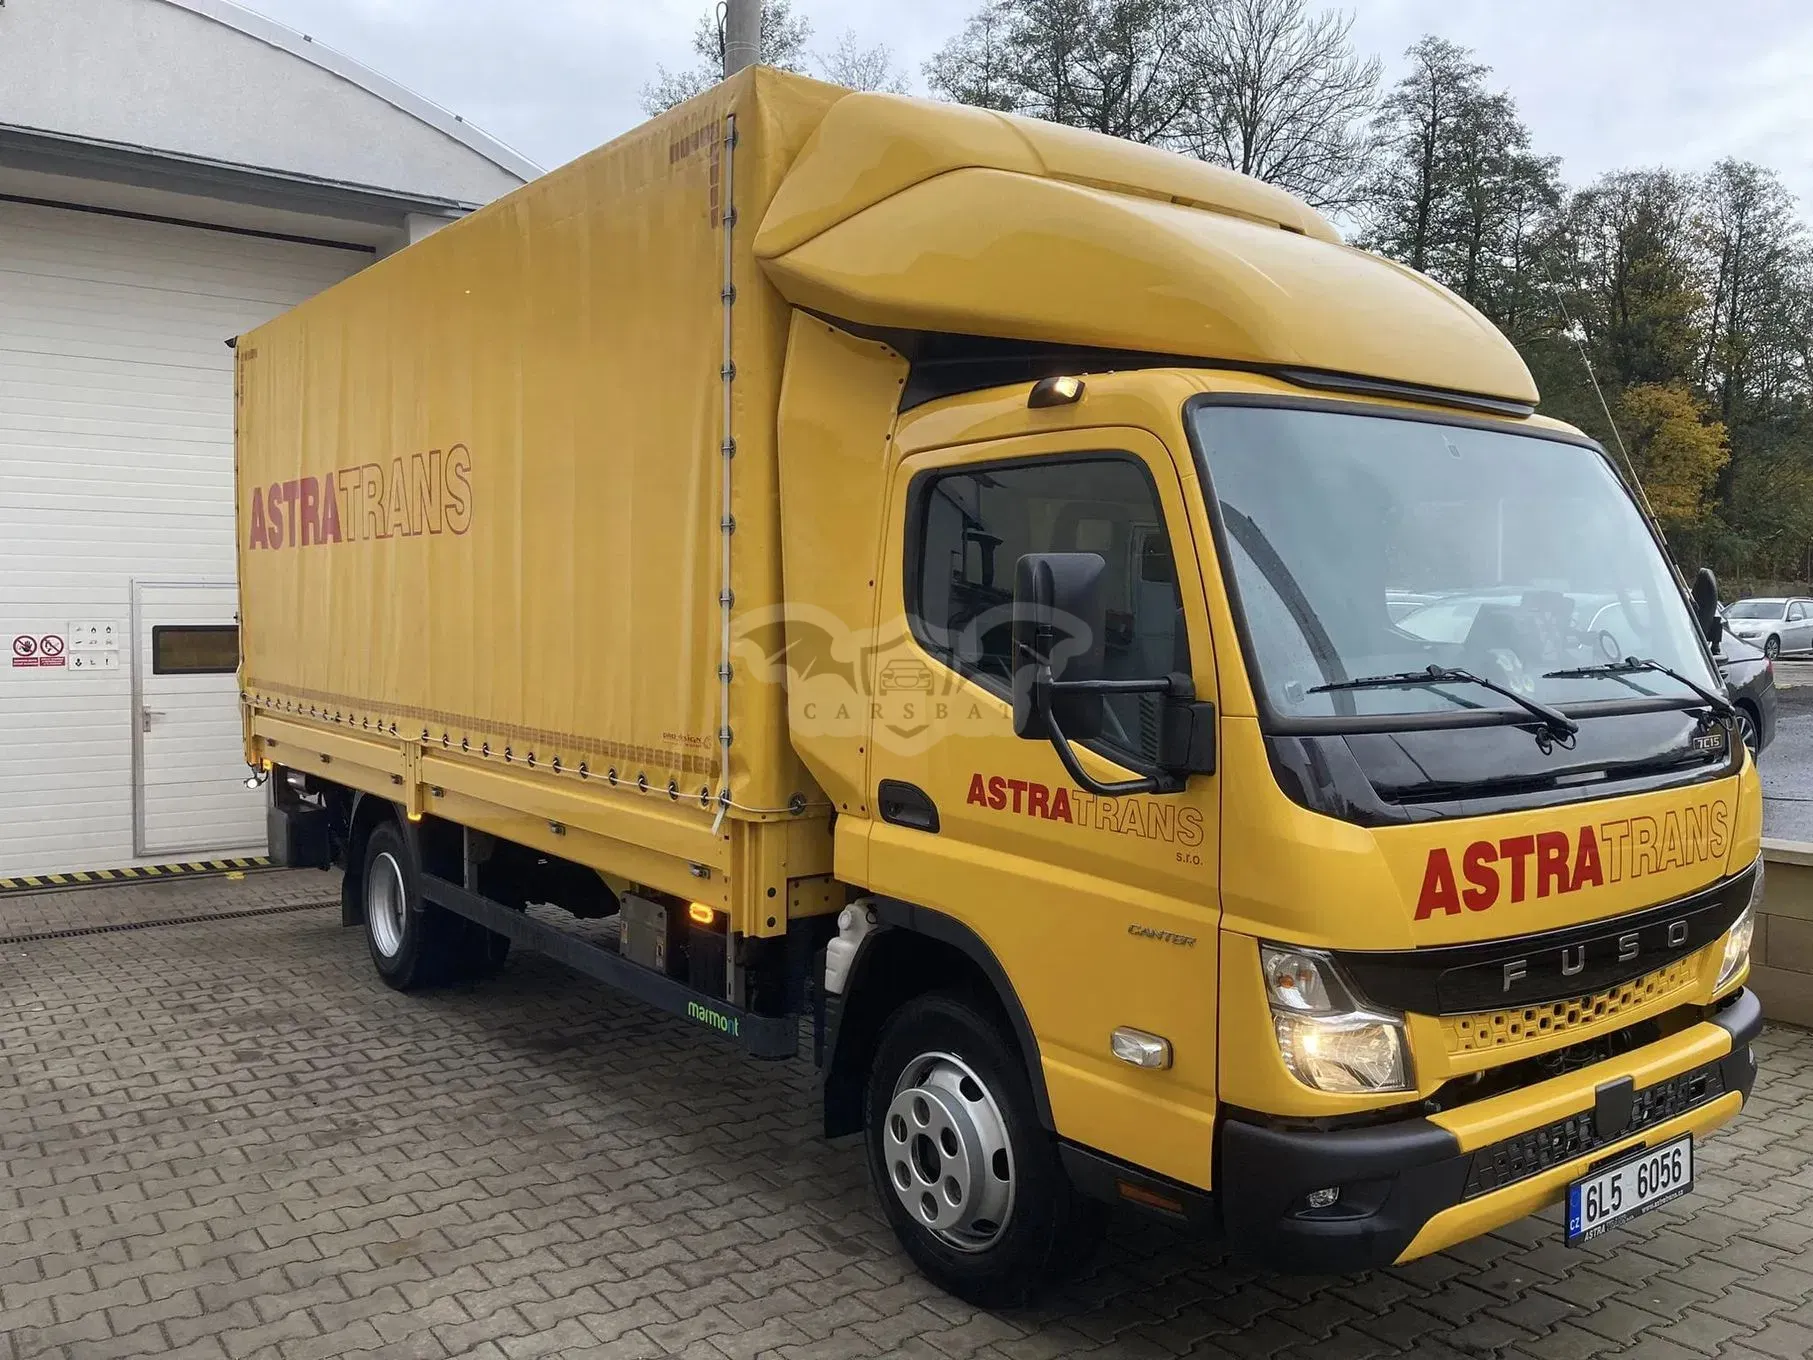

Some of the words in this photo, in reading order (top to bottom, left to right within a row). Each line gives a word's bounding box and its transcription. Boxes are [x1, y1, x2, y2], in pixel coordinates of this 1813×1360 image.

[249, 442, 473, 550] ASTRATRANS
[1697, 737, 1720, 749] 7C15
[966, 773, 1204, 848] ASTRATRANS
[1175, 852, 1204, 866] s.r.o.
[1413, 799, 1729, 921] ASTRATRANS
[1127, 924, 1198, 947] CANTER
[1503, 919, 1689, 993] FUSO
[687, 1001, 739, 1037] marmont
[1586, 1172, 1623, 1223] 6L5
[1637, 1147, 1682, 1199] 6056
[1569, 1216, 1580, 1231] CZ
